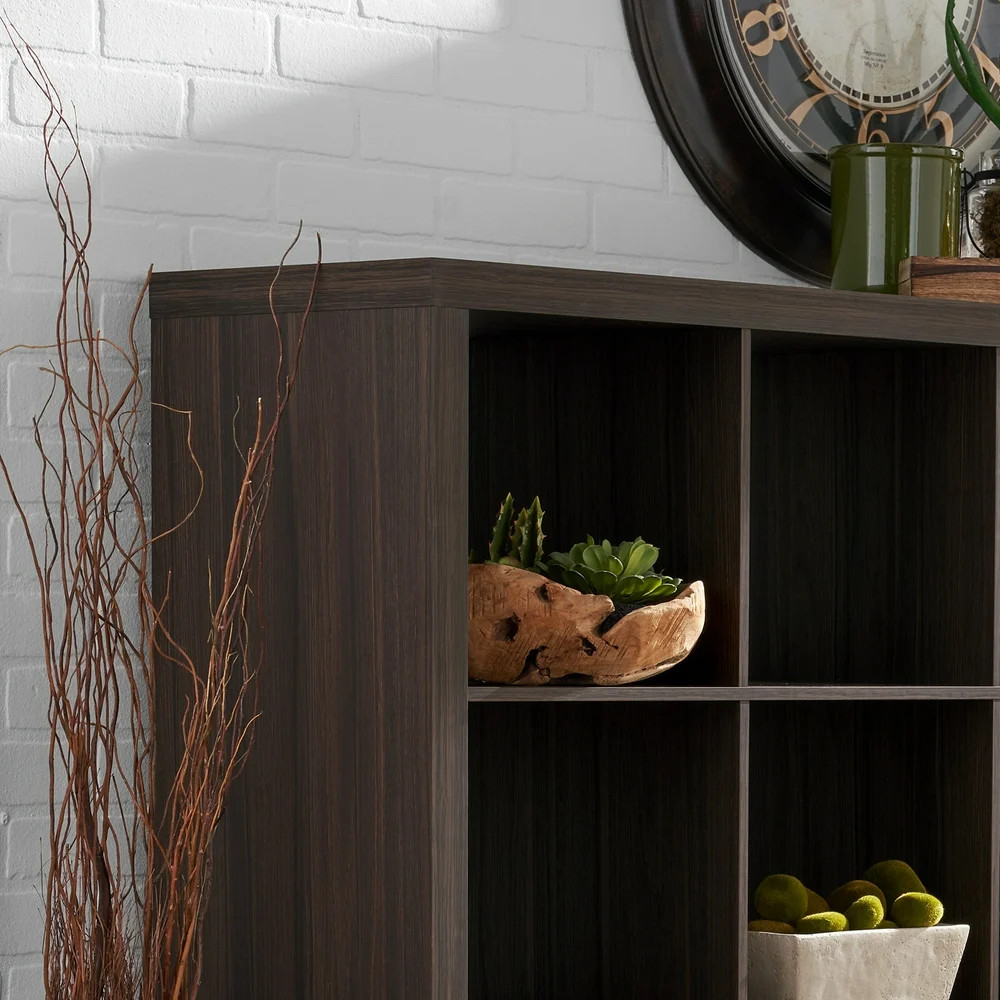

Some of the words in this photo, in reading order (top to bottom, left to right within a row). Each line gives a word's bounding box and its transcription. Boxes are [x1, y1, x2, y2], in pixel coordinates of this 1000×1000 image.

[742, 3, 788, 57] 8
[789, 69, 838, 126] 7
[857, 109, 890, 144] 6
